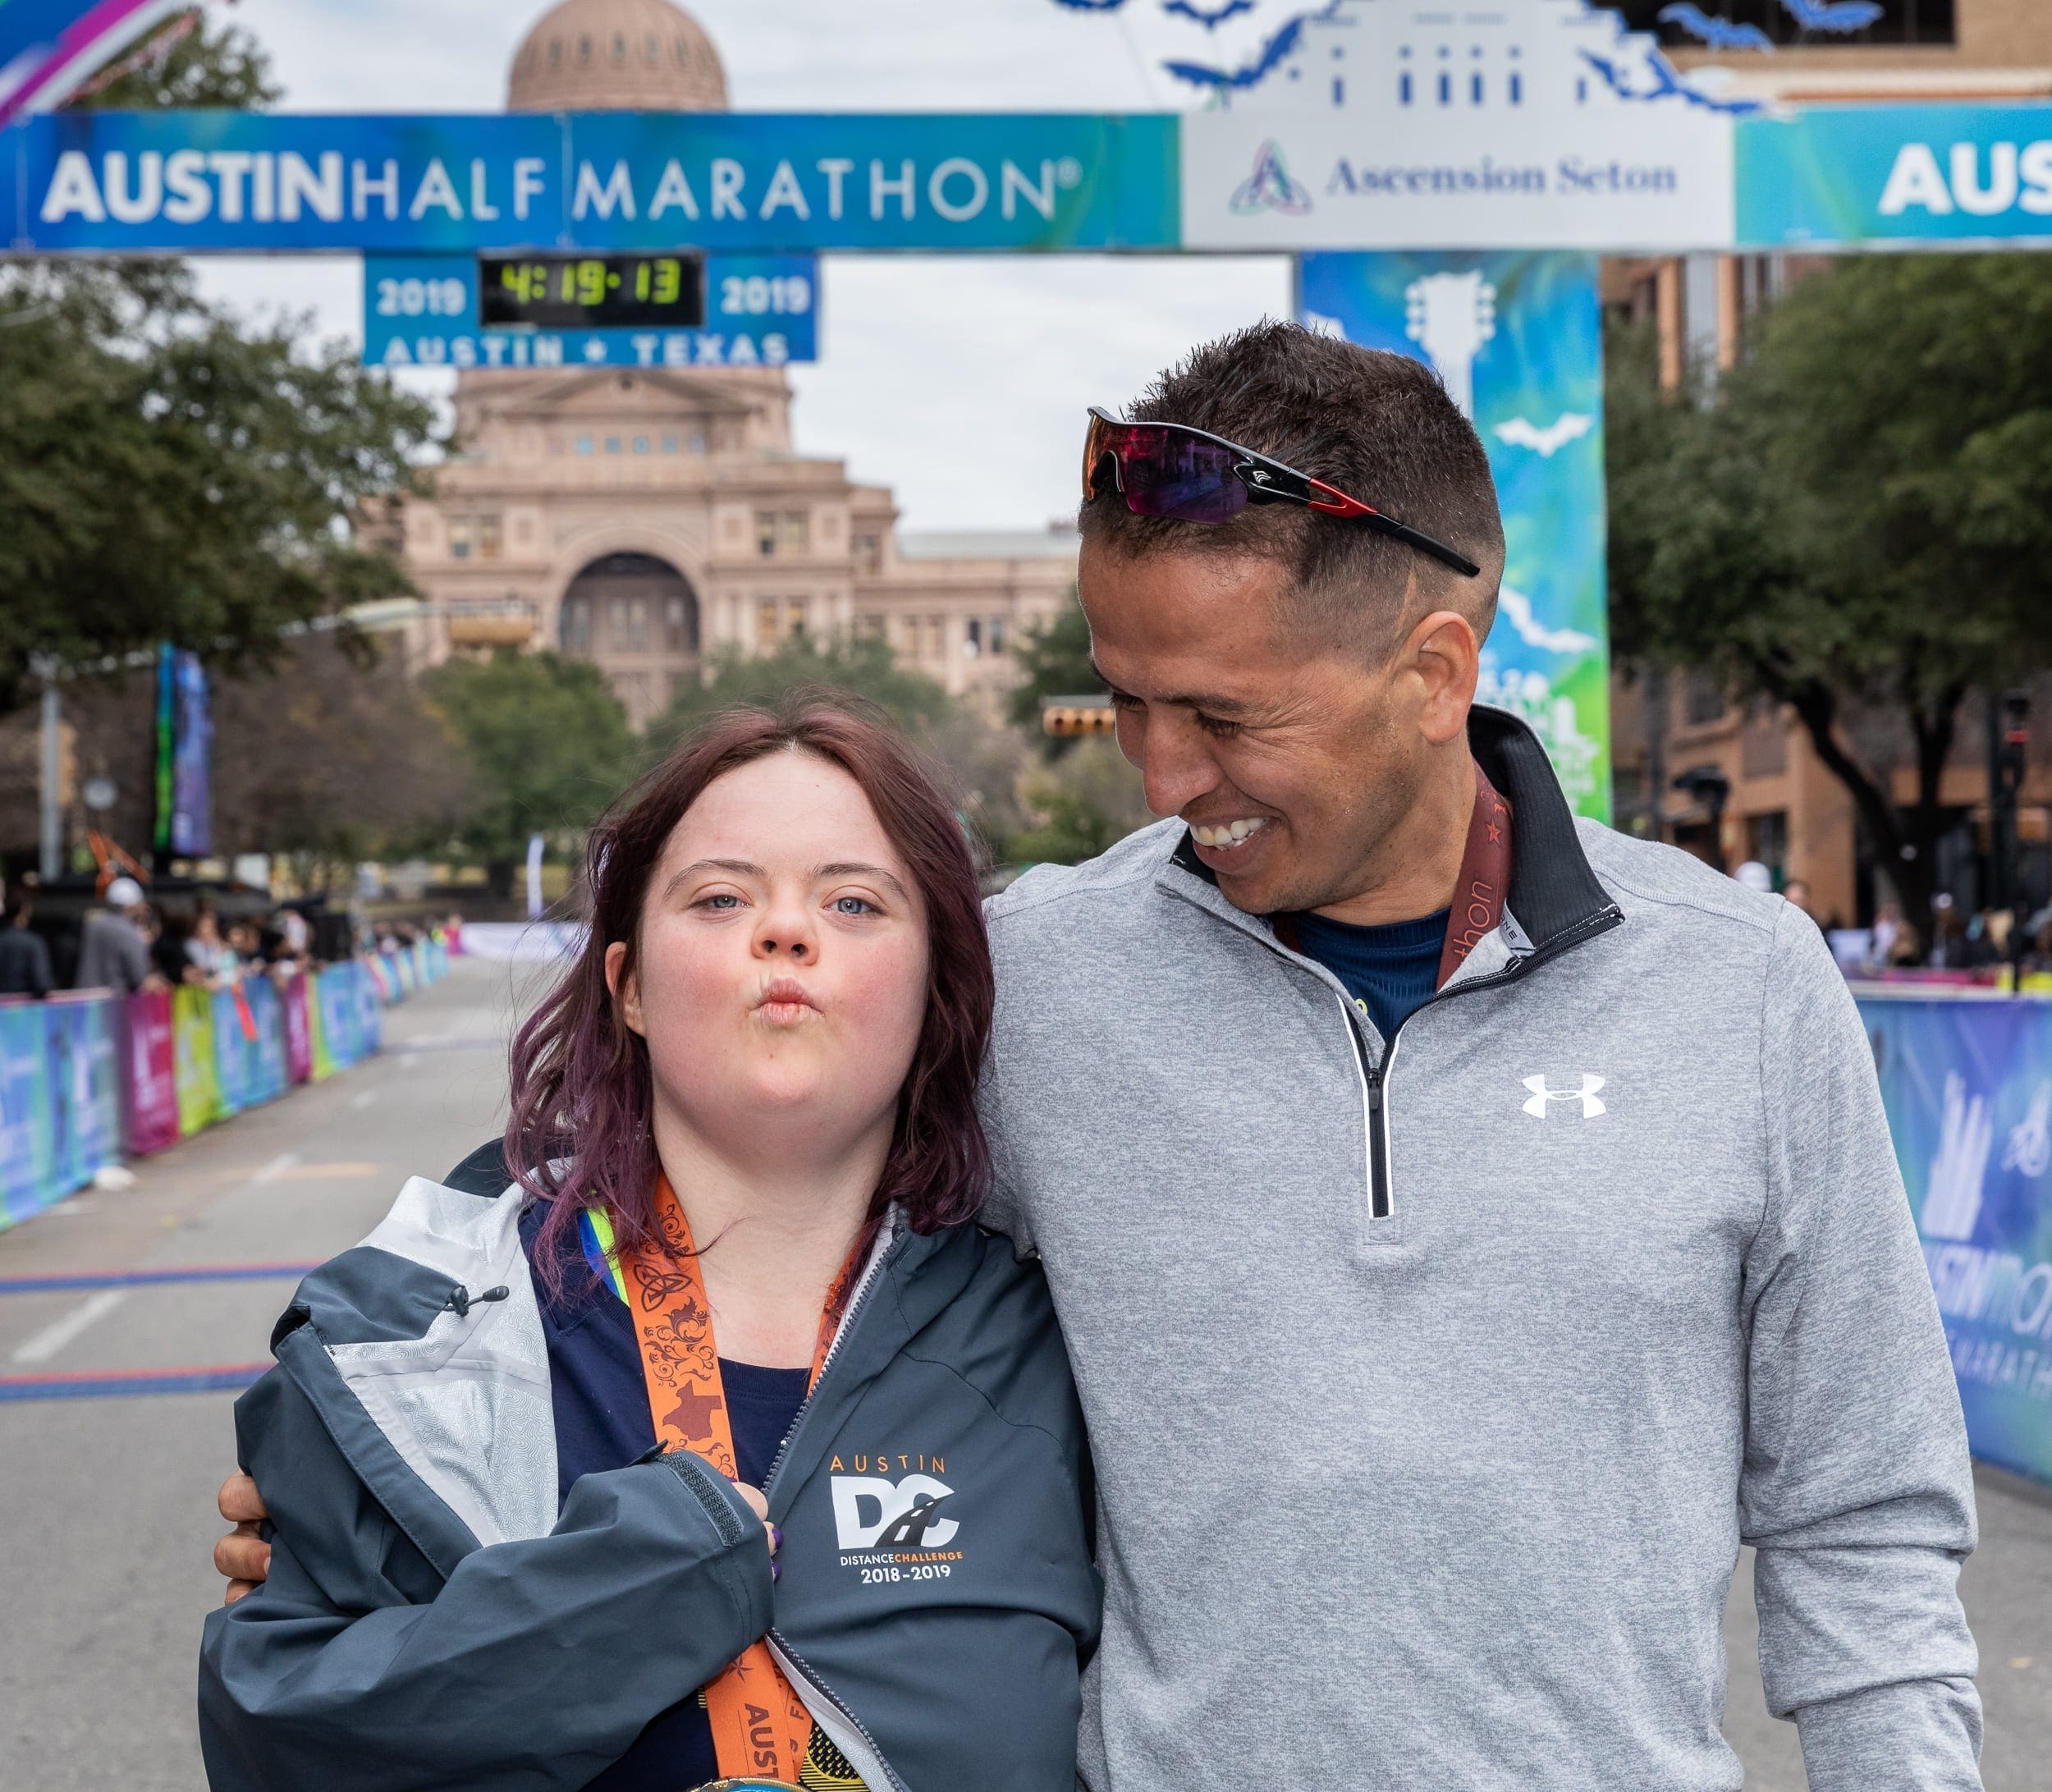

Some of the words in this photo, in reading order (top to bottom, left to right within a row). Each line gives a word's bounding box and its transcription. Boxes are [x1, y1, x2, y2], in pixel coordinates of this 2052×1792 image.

[1325, 155, 1545, 195] Ascension
[1558, 155, 1676, 195] Seton
[376, 278, 466, 316] 2019
[721, 276, 811, 314] 2019
[382, 335, 563, 366] AUSTIN
[630, 332, 788, 364] TEXAS
[830, 1455, 945, 1473] AUSTIN
[831, 1473, 960, 1550] DC
